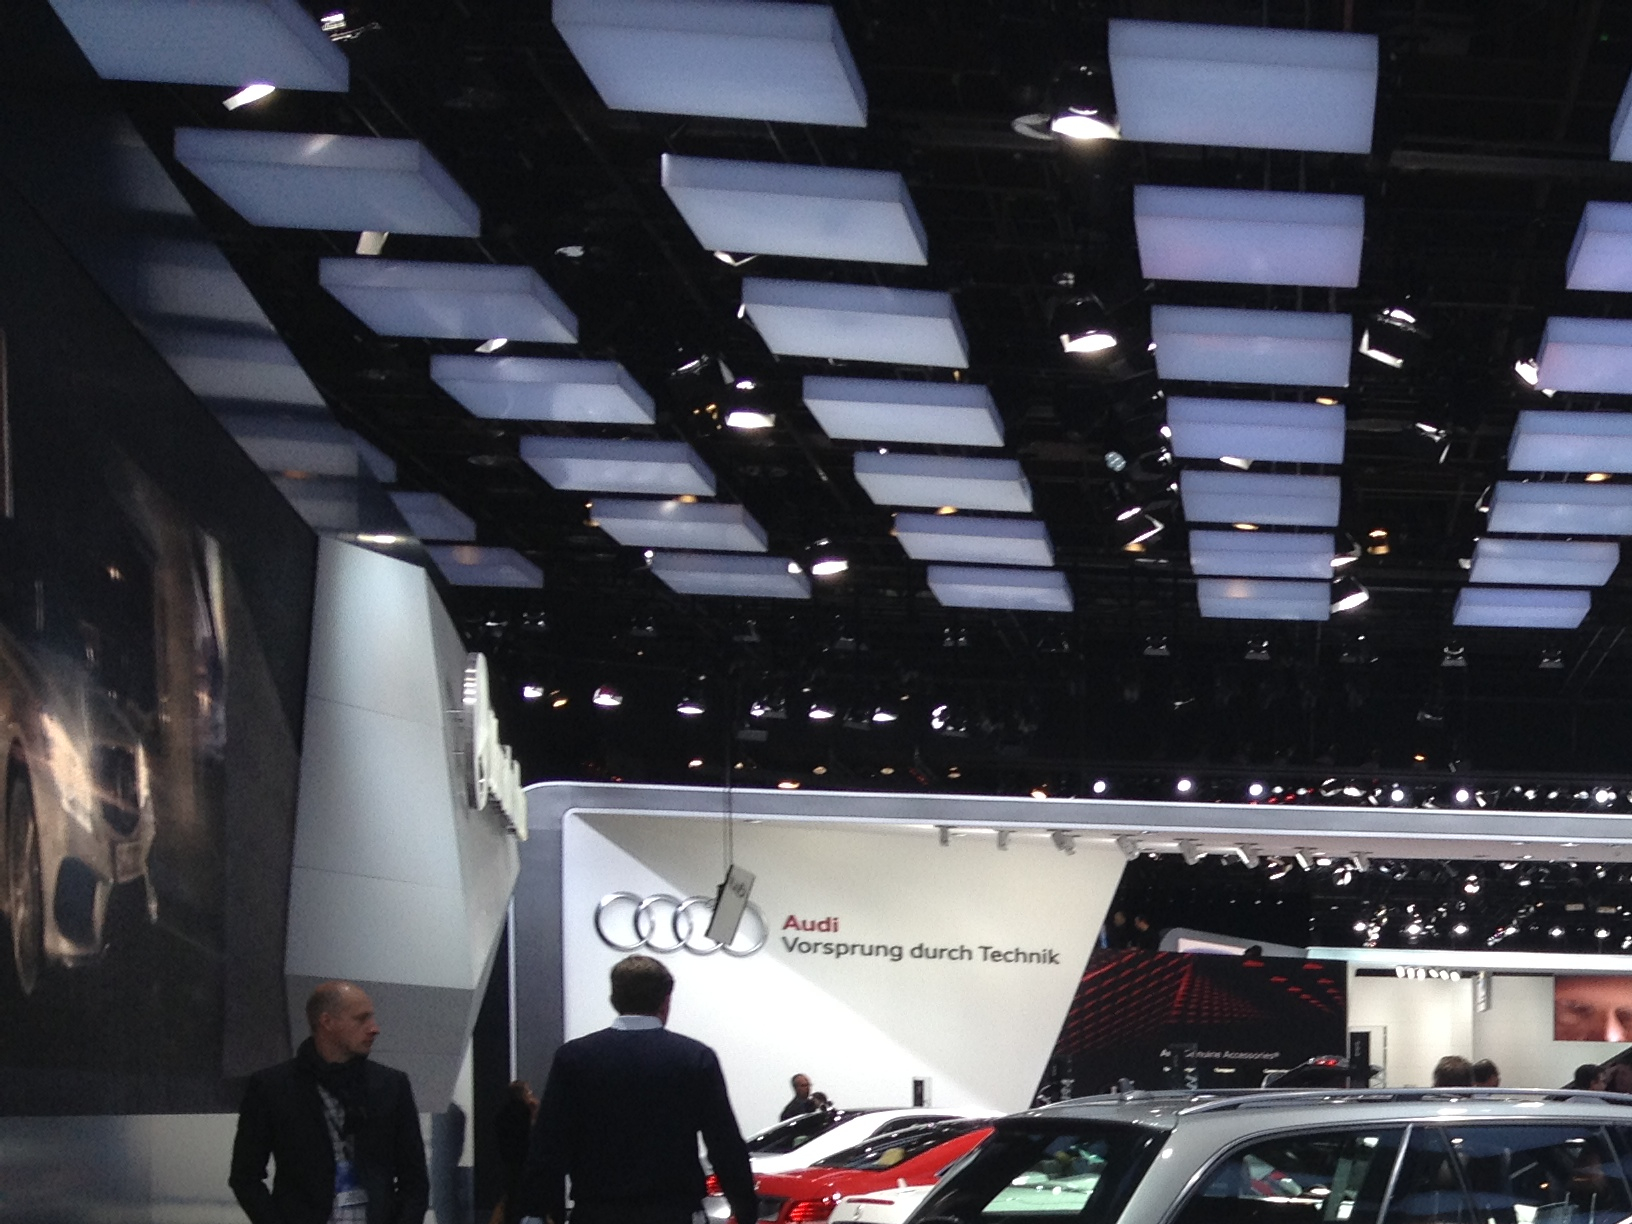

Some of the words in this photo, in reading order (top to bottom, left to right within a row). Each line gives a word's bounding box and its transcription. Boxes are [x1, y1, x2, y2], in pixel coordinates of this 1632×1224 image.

[782, 914, 840, 932] Audi
[782, 936, 903, 961] Vorsprung
[911, 943, 972, 961] durch
[978, 945, 1060, 965] Technik
